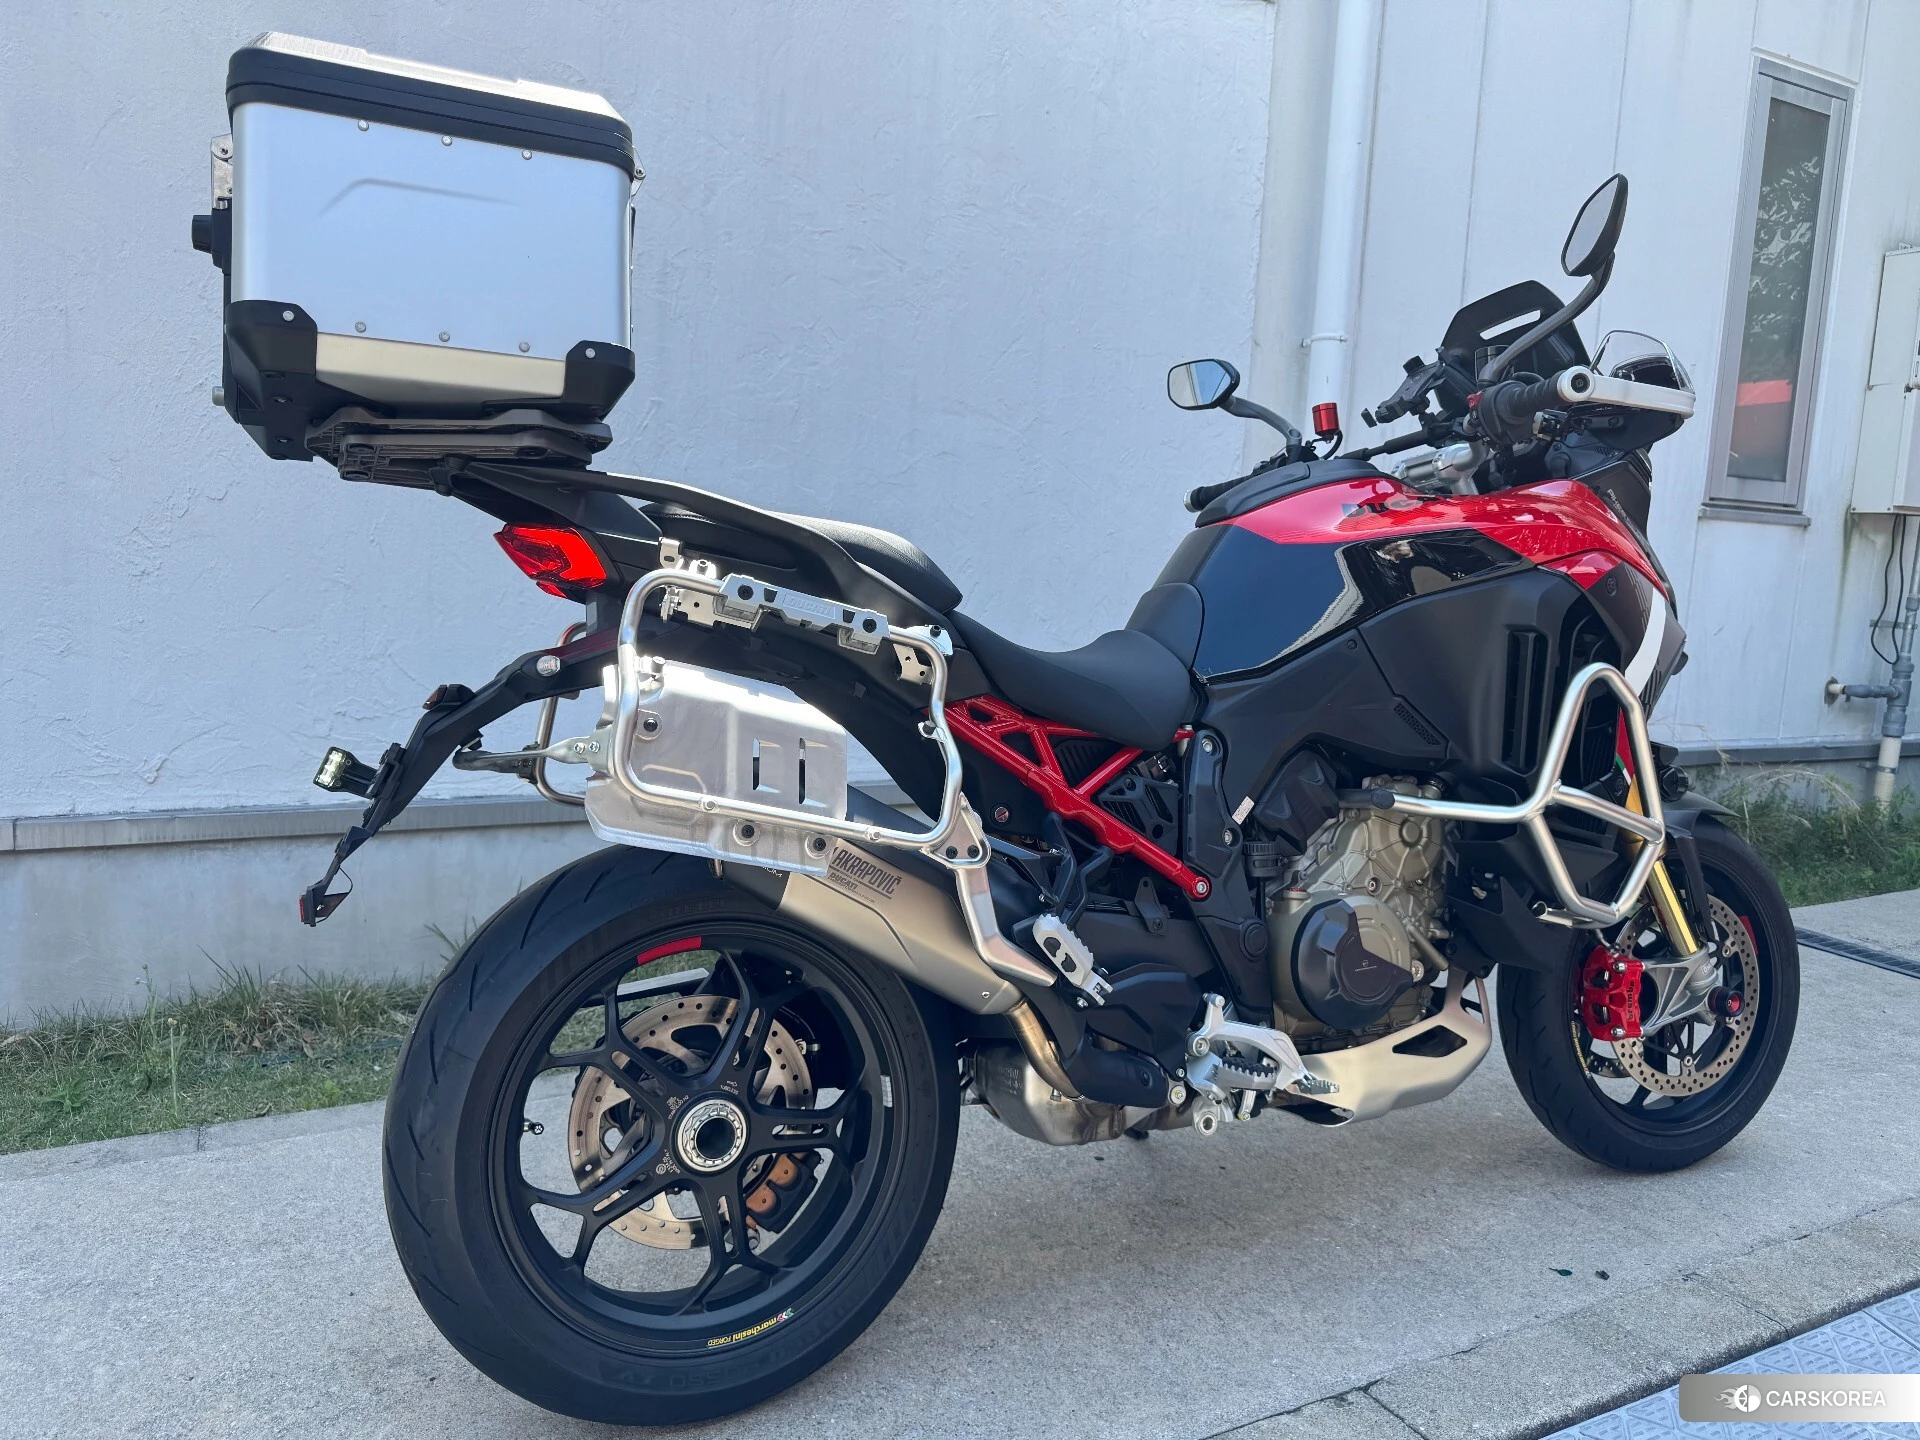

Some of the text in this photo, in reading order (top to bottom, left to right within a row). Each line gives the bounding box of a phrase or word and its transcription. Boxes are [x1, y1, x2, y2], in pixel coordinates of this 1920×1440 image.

[1341, 496, 1441, 518] DUCA
[828, 871, 859, 890] DUCATI
[832, 848, 902, 895] AKRAPOVIČ
[1627, 980, 1635, 1021] brembo
[707, 1317, 777, 1347] marchesini FORGED
